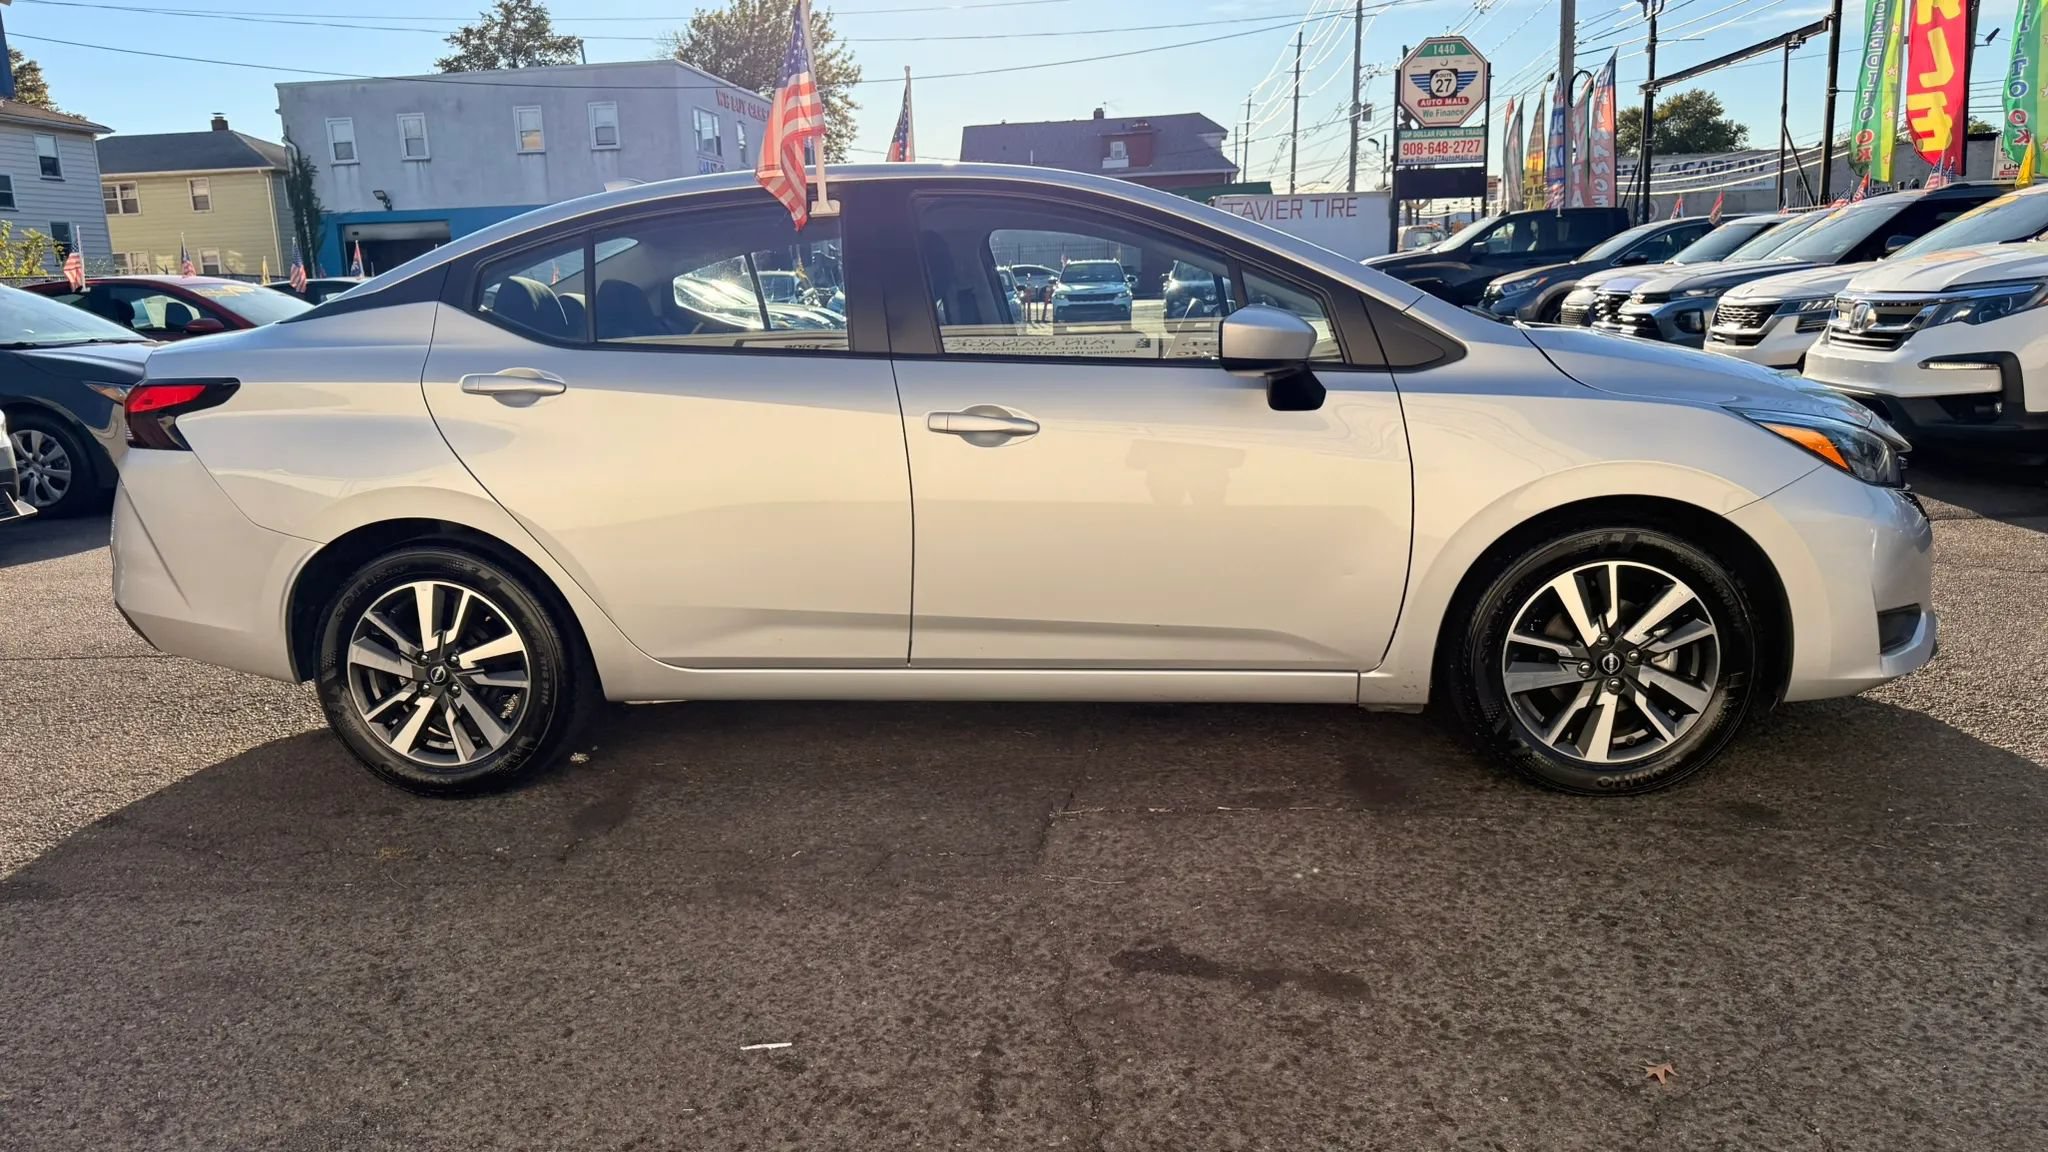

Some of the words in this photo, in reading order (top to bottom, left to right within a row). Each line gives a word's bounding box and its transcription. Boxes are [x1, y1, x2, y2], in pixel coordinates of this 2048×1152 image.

[1433, 44, 1456, 55] 1440
[1435, 78, 1453, 93] 27
[1420, 98, 1443, 106] AUTO
[1444, 97, 1467, 105] MALL
[1422, 110, 1434, 118] We
[1435, 108, 1465, 117] Finance
[1412, 130, 1435, 138] DOLLAR
[1448, 129, 1465, 137] YOUR
[1402, 140, 1481, 156] 908-648-2727
[1669, 159, 1769, 177] ACADEMY
[1310, 197, 1359, 219] TIRE
